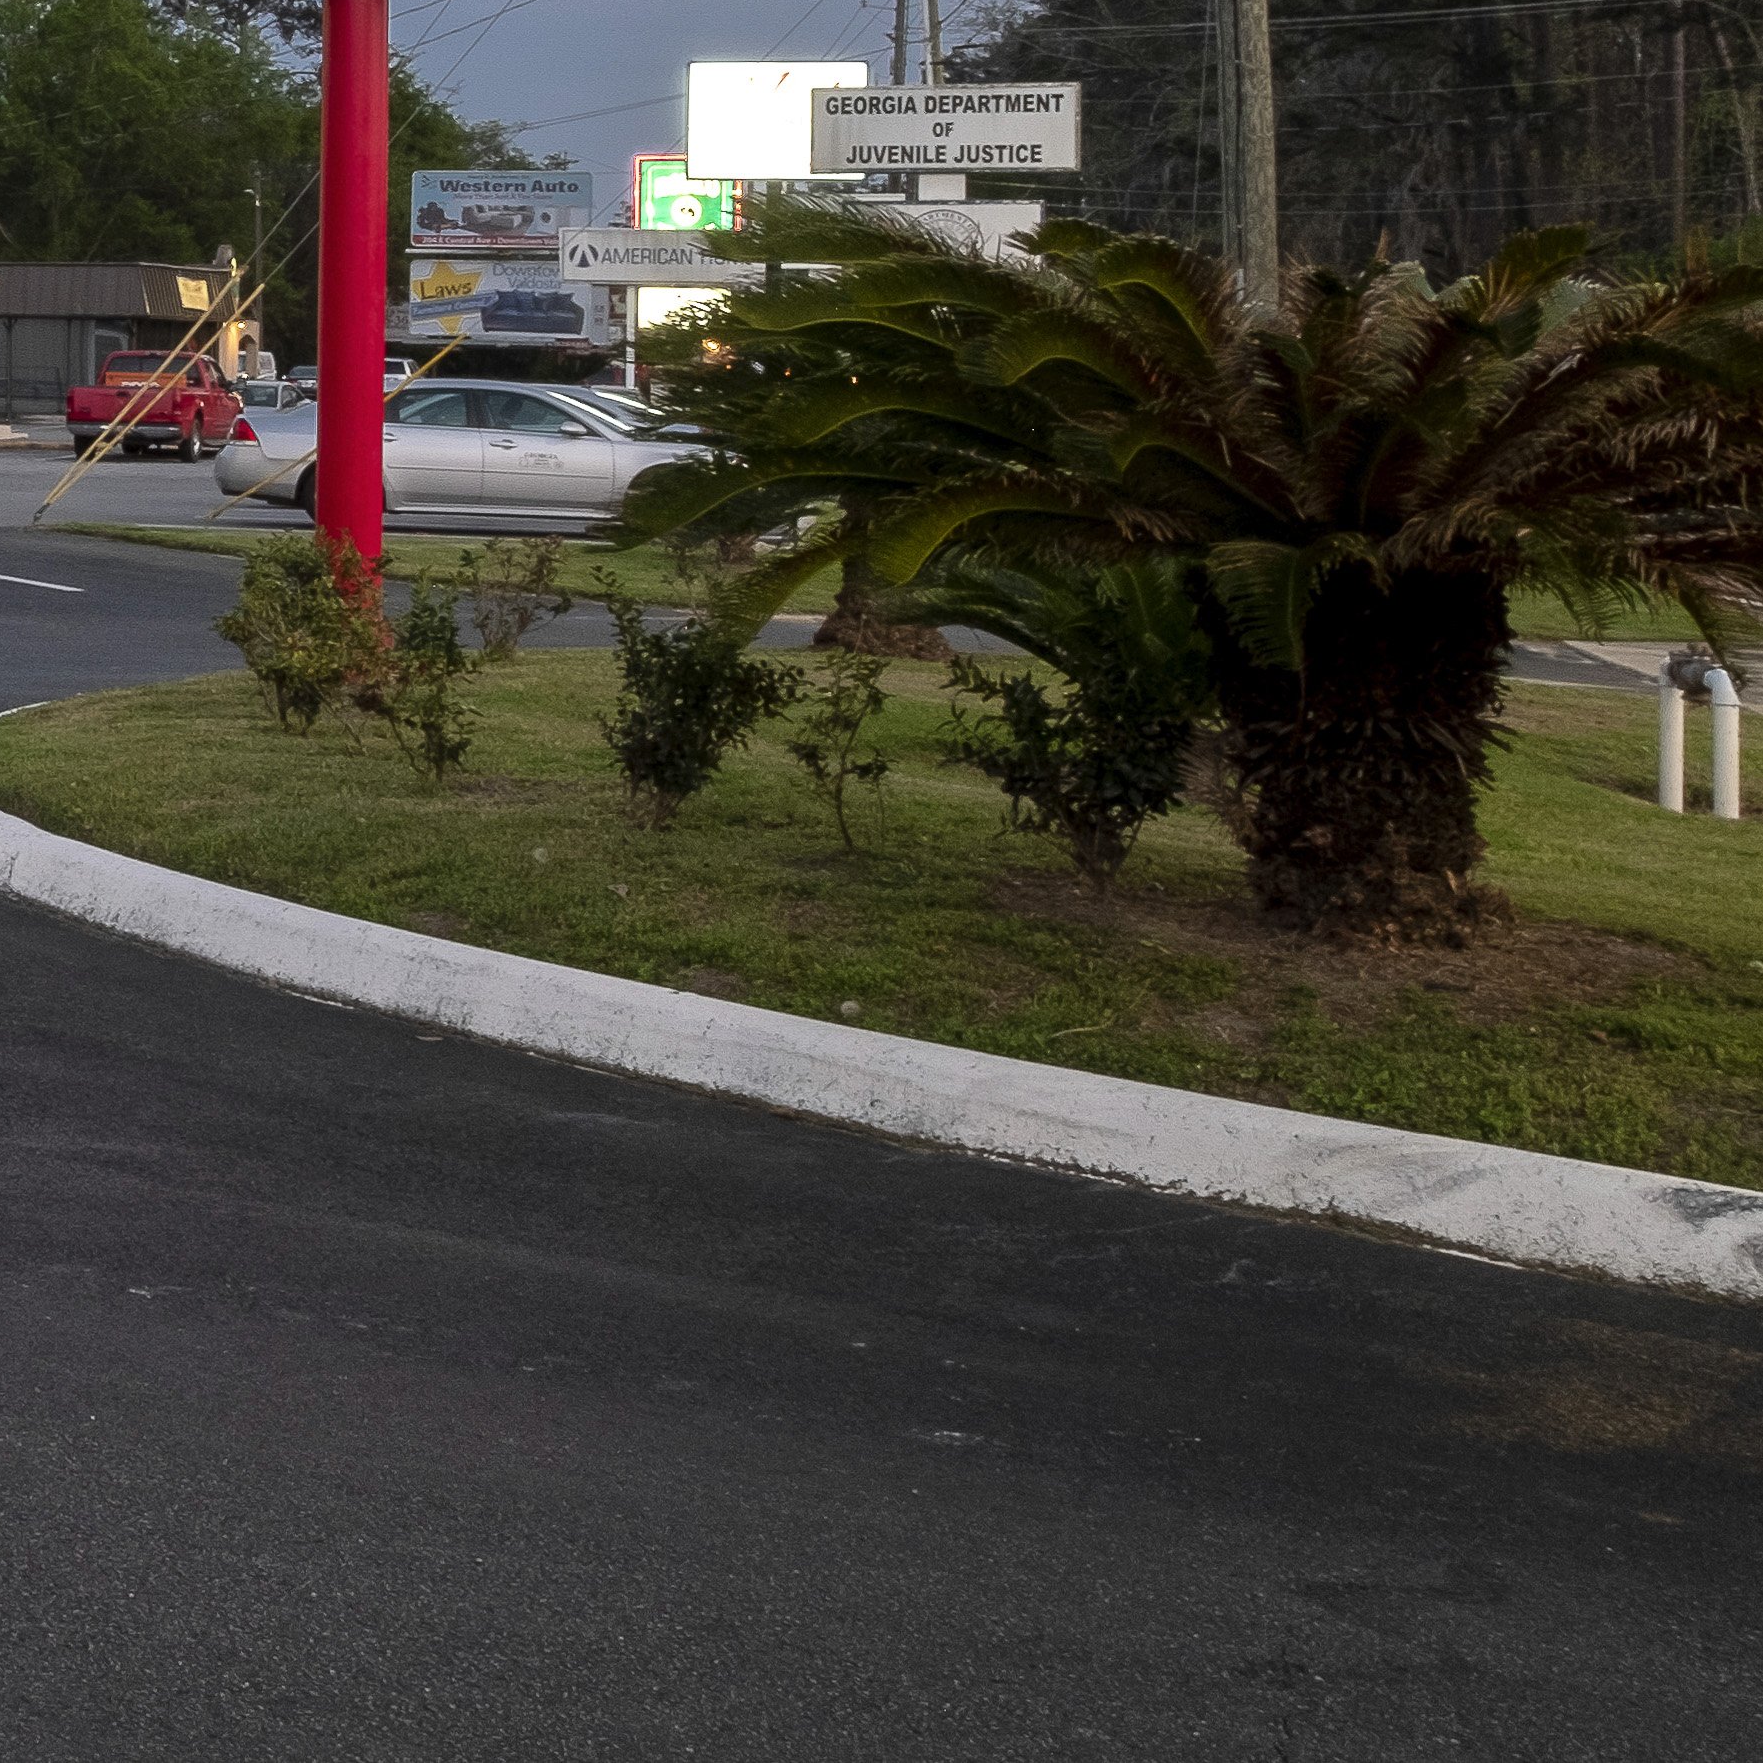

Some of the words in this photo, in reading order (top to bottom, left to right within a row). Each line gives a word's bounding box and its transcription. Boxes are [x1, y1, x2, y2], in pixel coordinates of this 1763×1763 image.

[826, 95, 917, 116] GEORGIA
[924, 93, 1065, 114] DEPARTMENT
[932, 121, 954, 138] OF
[846, 145, 947, 164] JUVENILE
[954, 143, 1043, 163] JUSTICE
[439, 179, 526, 193] Western
[531, 179, 579, 193] Auto
[601, 247, 693, 265] AMERICAN
[419, 281, 472, 300] Laws
